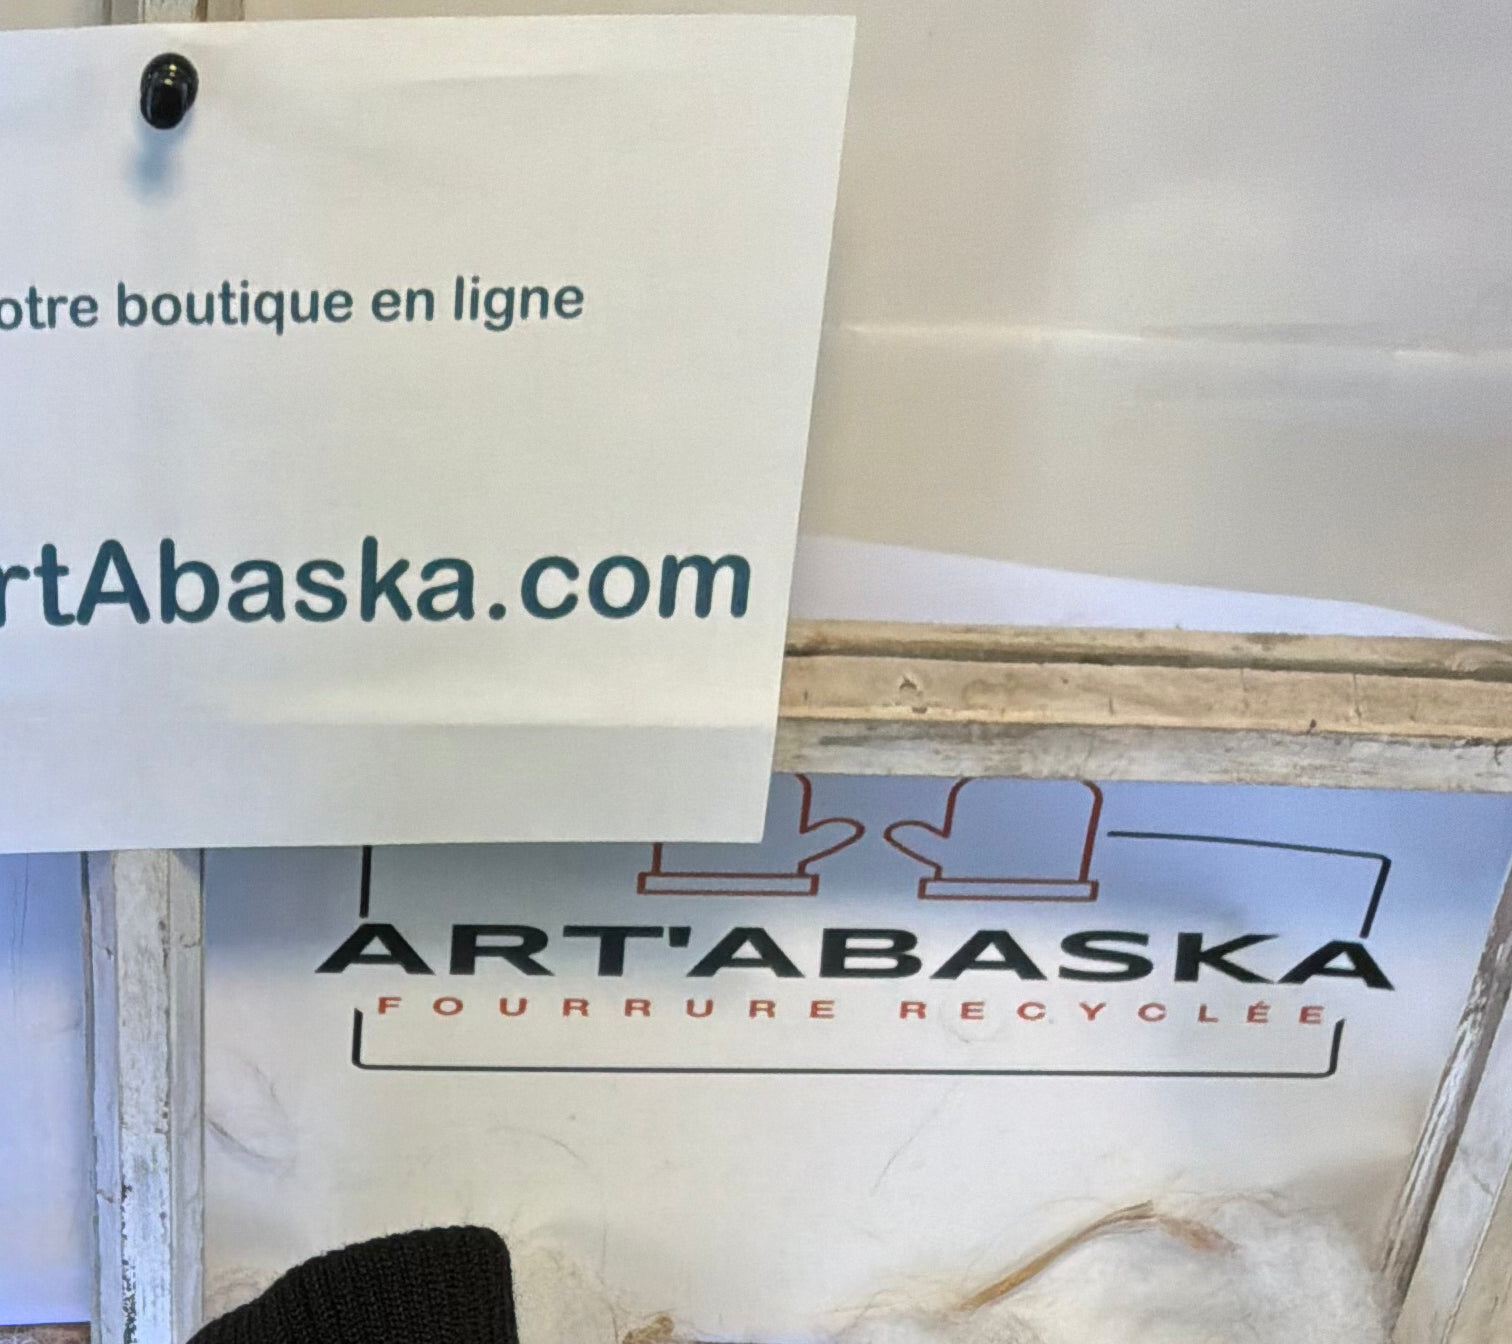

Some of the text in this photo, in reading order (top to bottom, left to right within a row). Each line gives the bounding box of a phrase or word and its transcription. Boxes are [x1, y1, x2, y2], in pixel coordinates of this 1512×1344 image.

[116, 279, 355, 337] boutique
[370, 287, 436, 323] en
[453, 274, 585, 333] ligne
[313, 920, 1395, 992] ART'ABASKA
[376, 995, 1324, 1025] FOURRURE RECYCLÉE
